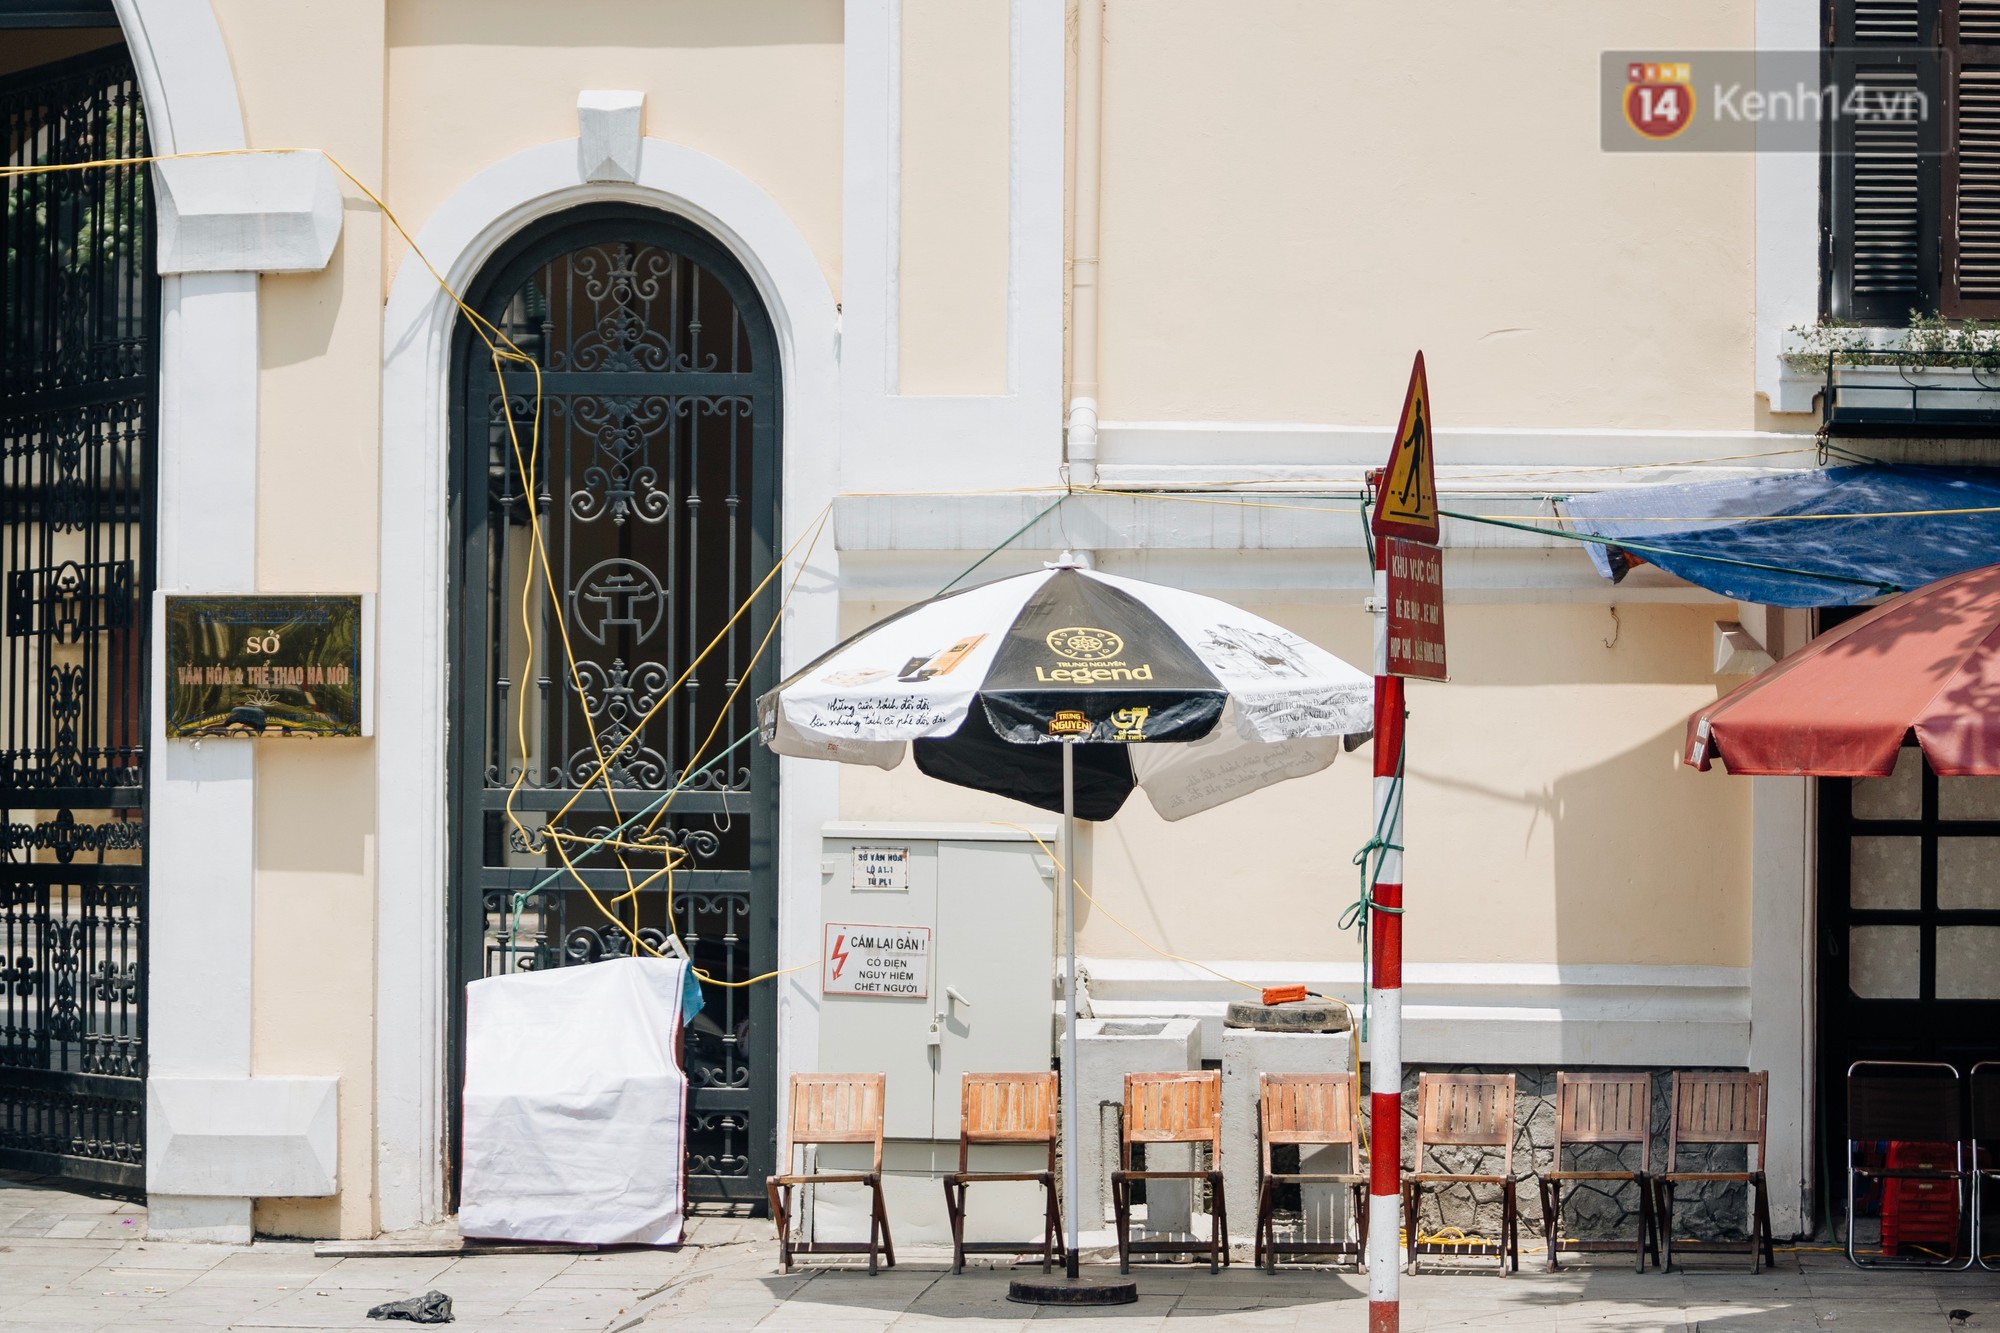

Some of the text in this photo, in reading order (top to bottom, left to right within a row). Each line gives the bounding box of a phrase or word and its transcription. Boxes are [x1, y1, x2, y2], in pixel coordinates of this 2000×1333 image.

[1392, 555, 1408, 579] KHU
[246, 629, 280, 654] SỞ
[178, 660, 349, 689] VĂN HÓA & THỂ THAO HÀ NỘI
[1035, 664, 1153, 684] Legend
[1058, 712, 1081, 720] TRUNG
[1050, 720, 1090, 732] NGUYÊN
[851, 934, 874, 948] CẤM
[877, 938, 893, 951] LẠI
[866, 957, 907, 969] CÓ ĐIỆN
[859, 970, 887, 980] NGUY
[884, 983, 917, 993] NGƯỜI
